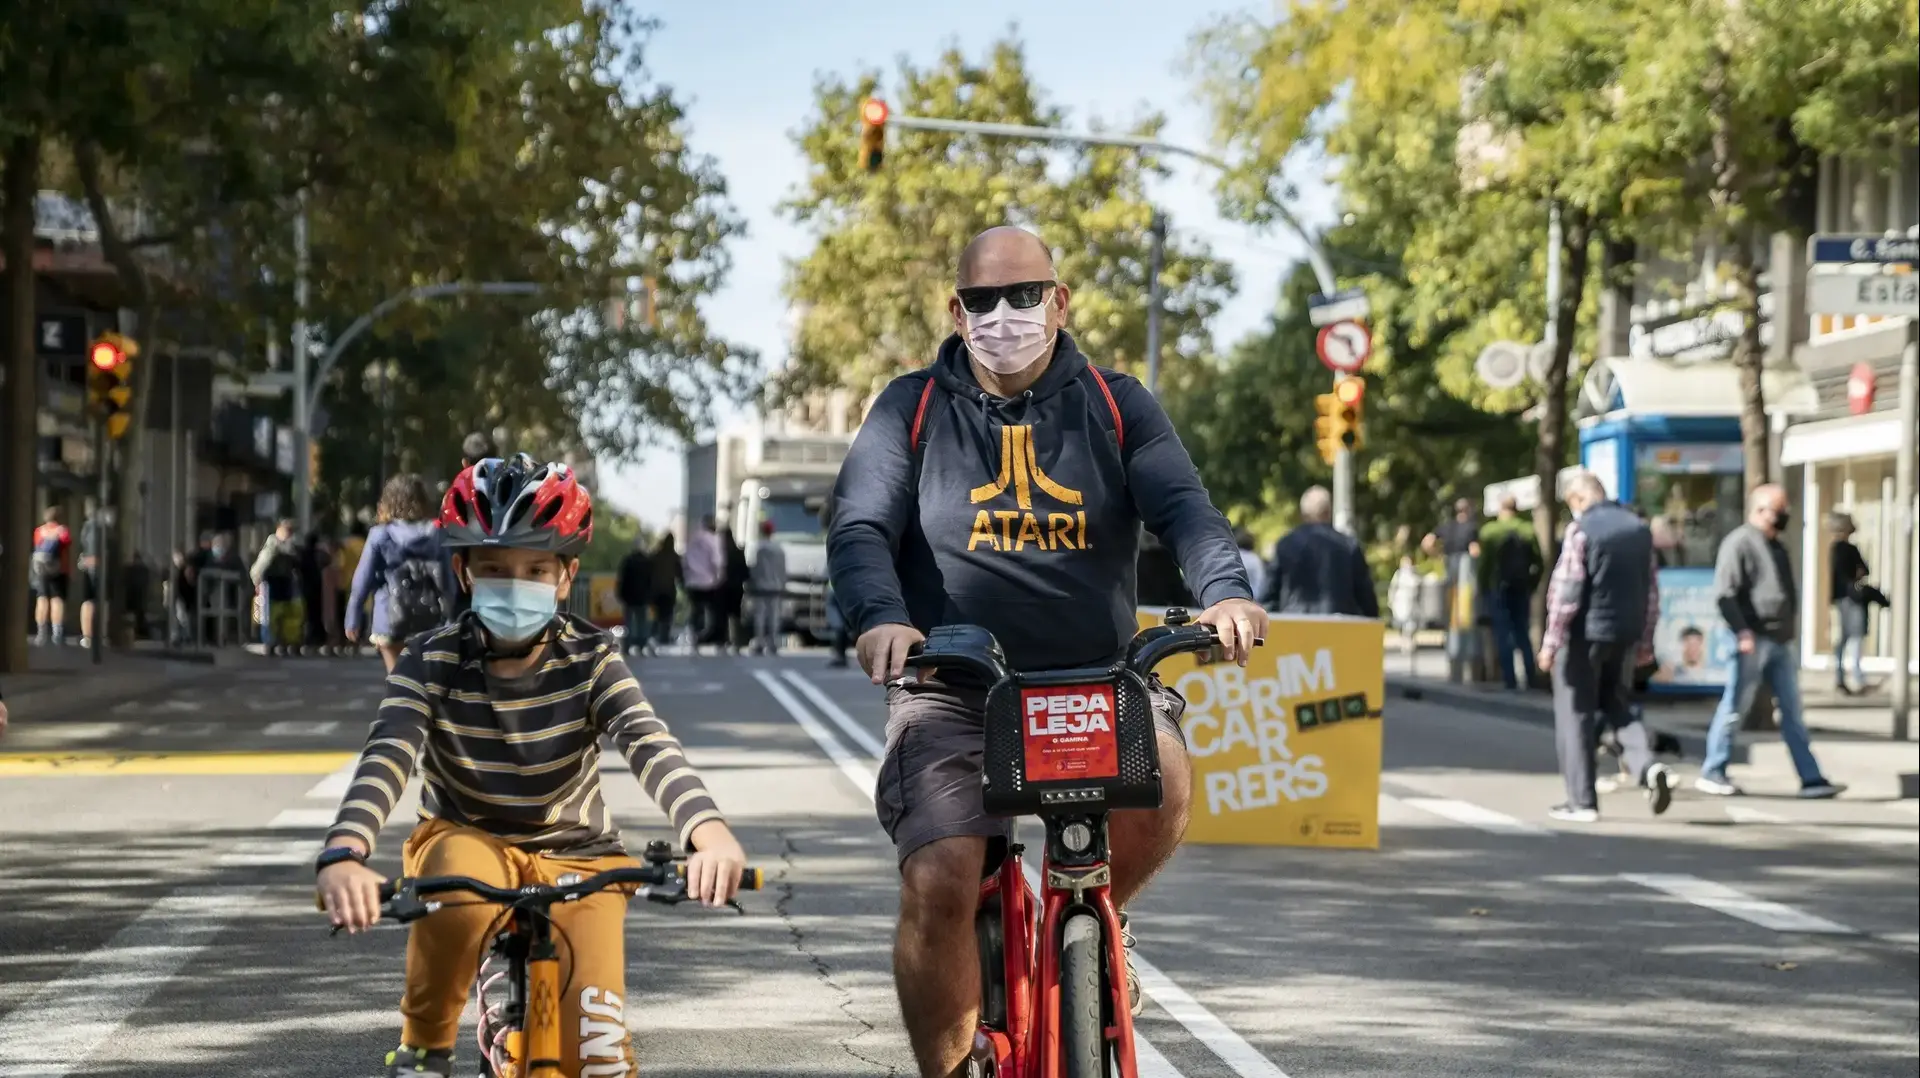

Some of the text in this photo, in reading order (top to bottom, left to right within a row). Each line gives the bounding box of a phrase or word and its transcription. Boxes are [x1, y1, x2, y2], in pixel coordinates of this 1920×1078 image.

[967, 510, 1086, 551] ATARI
[1026, 693, 1110, 716] PEDA
[1175, 648, 1335, 722] OBRIM
[1028, 713, 1110, 736] LEJA
[1184, 709, 1293, 765] CAR
[1205, 754, 1328, 816] RERS
